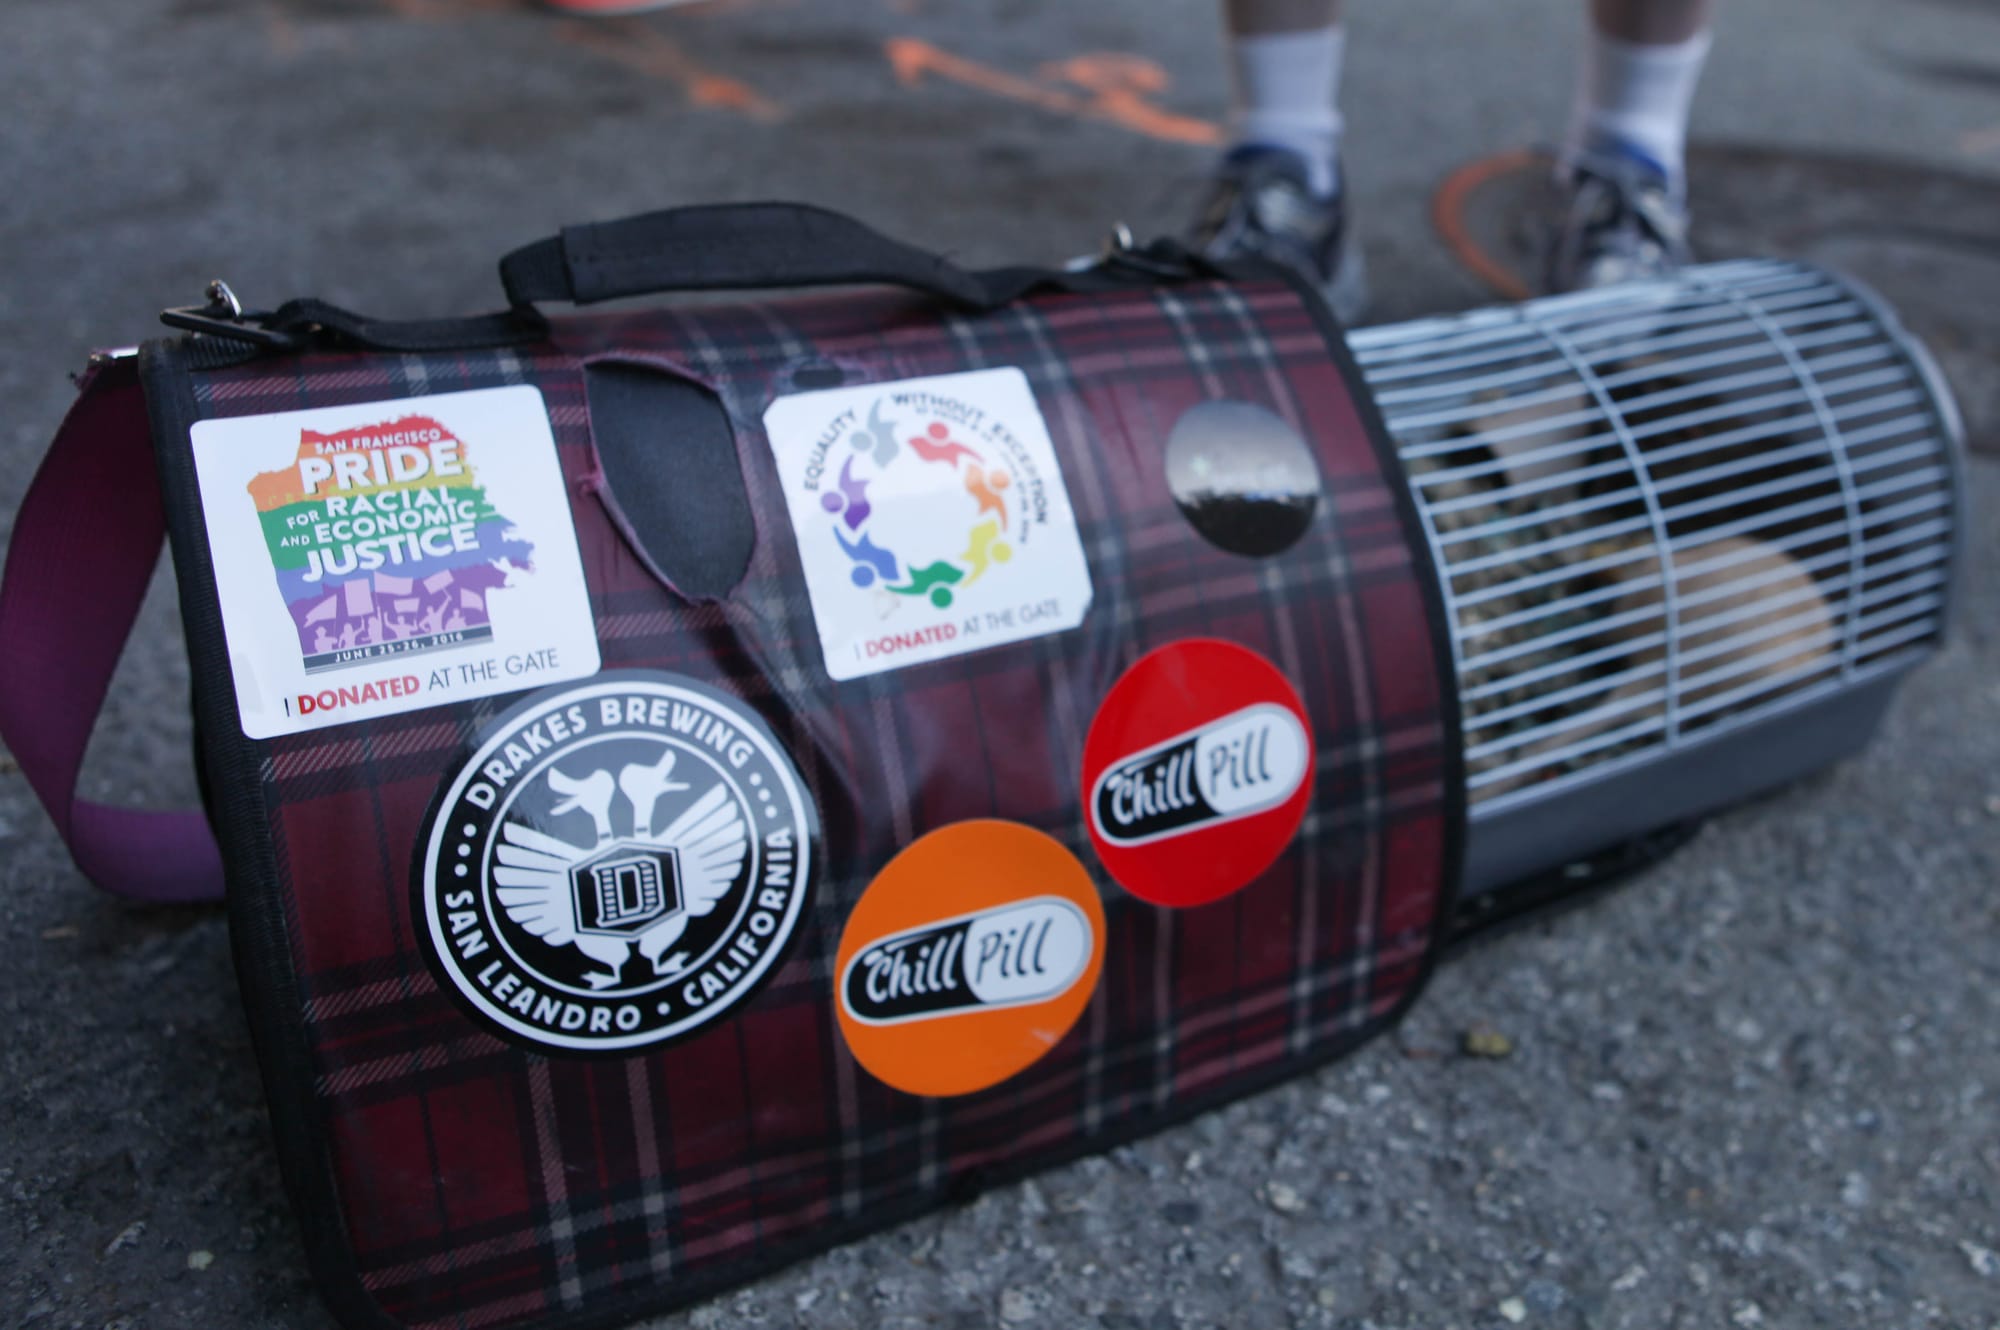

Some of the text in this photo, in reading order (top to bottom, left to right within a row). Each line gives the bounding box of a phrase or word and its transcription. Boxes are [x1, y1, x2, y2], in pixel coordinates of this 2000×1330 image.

[299, 439, 465, 496] PRIDE
[315, 428, 441, 455] SAN FRANCISCO
[803, 408, 858, 491] EQUALITY
[891, 391, 984, 424] WITHOUT
[991, 423, 1047, 524] EXCEPTION
[280, 500, 478, 548] AND ECONOMIC
[286, 485, 457, 529] FOR RACIAL
[302, 522, 480, 583] JUSTICE
[335, 647, 372, 663] JUNE
[432, 631, 463, 647] 2016
[866, 624, 957, 658] DONATED
[962, 619, 981, 636] AT
[986, 611, 1014, 629] THE
[1019, 599, 1061, 620] GATE
[298, 674, 420, 715] DONATED
[428, 668, 457, 691] AT
[462, 657, 498, 683] THE
[504, 647, 560, 675] GATE
[465, 697, 754, 811] DRAKES BREWING
[1106, 725, 1272, 826] Chill Pill
[445, 826, 793, 1033] SAN LEANDRO CALIFORNIA
[863, 917, 1053, 1004] Chill Pill
